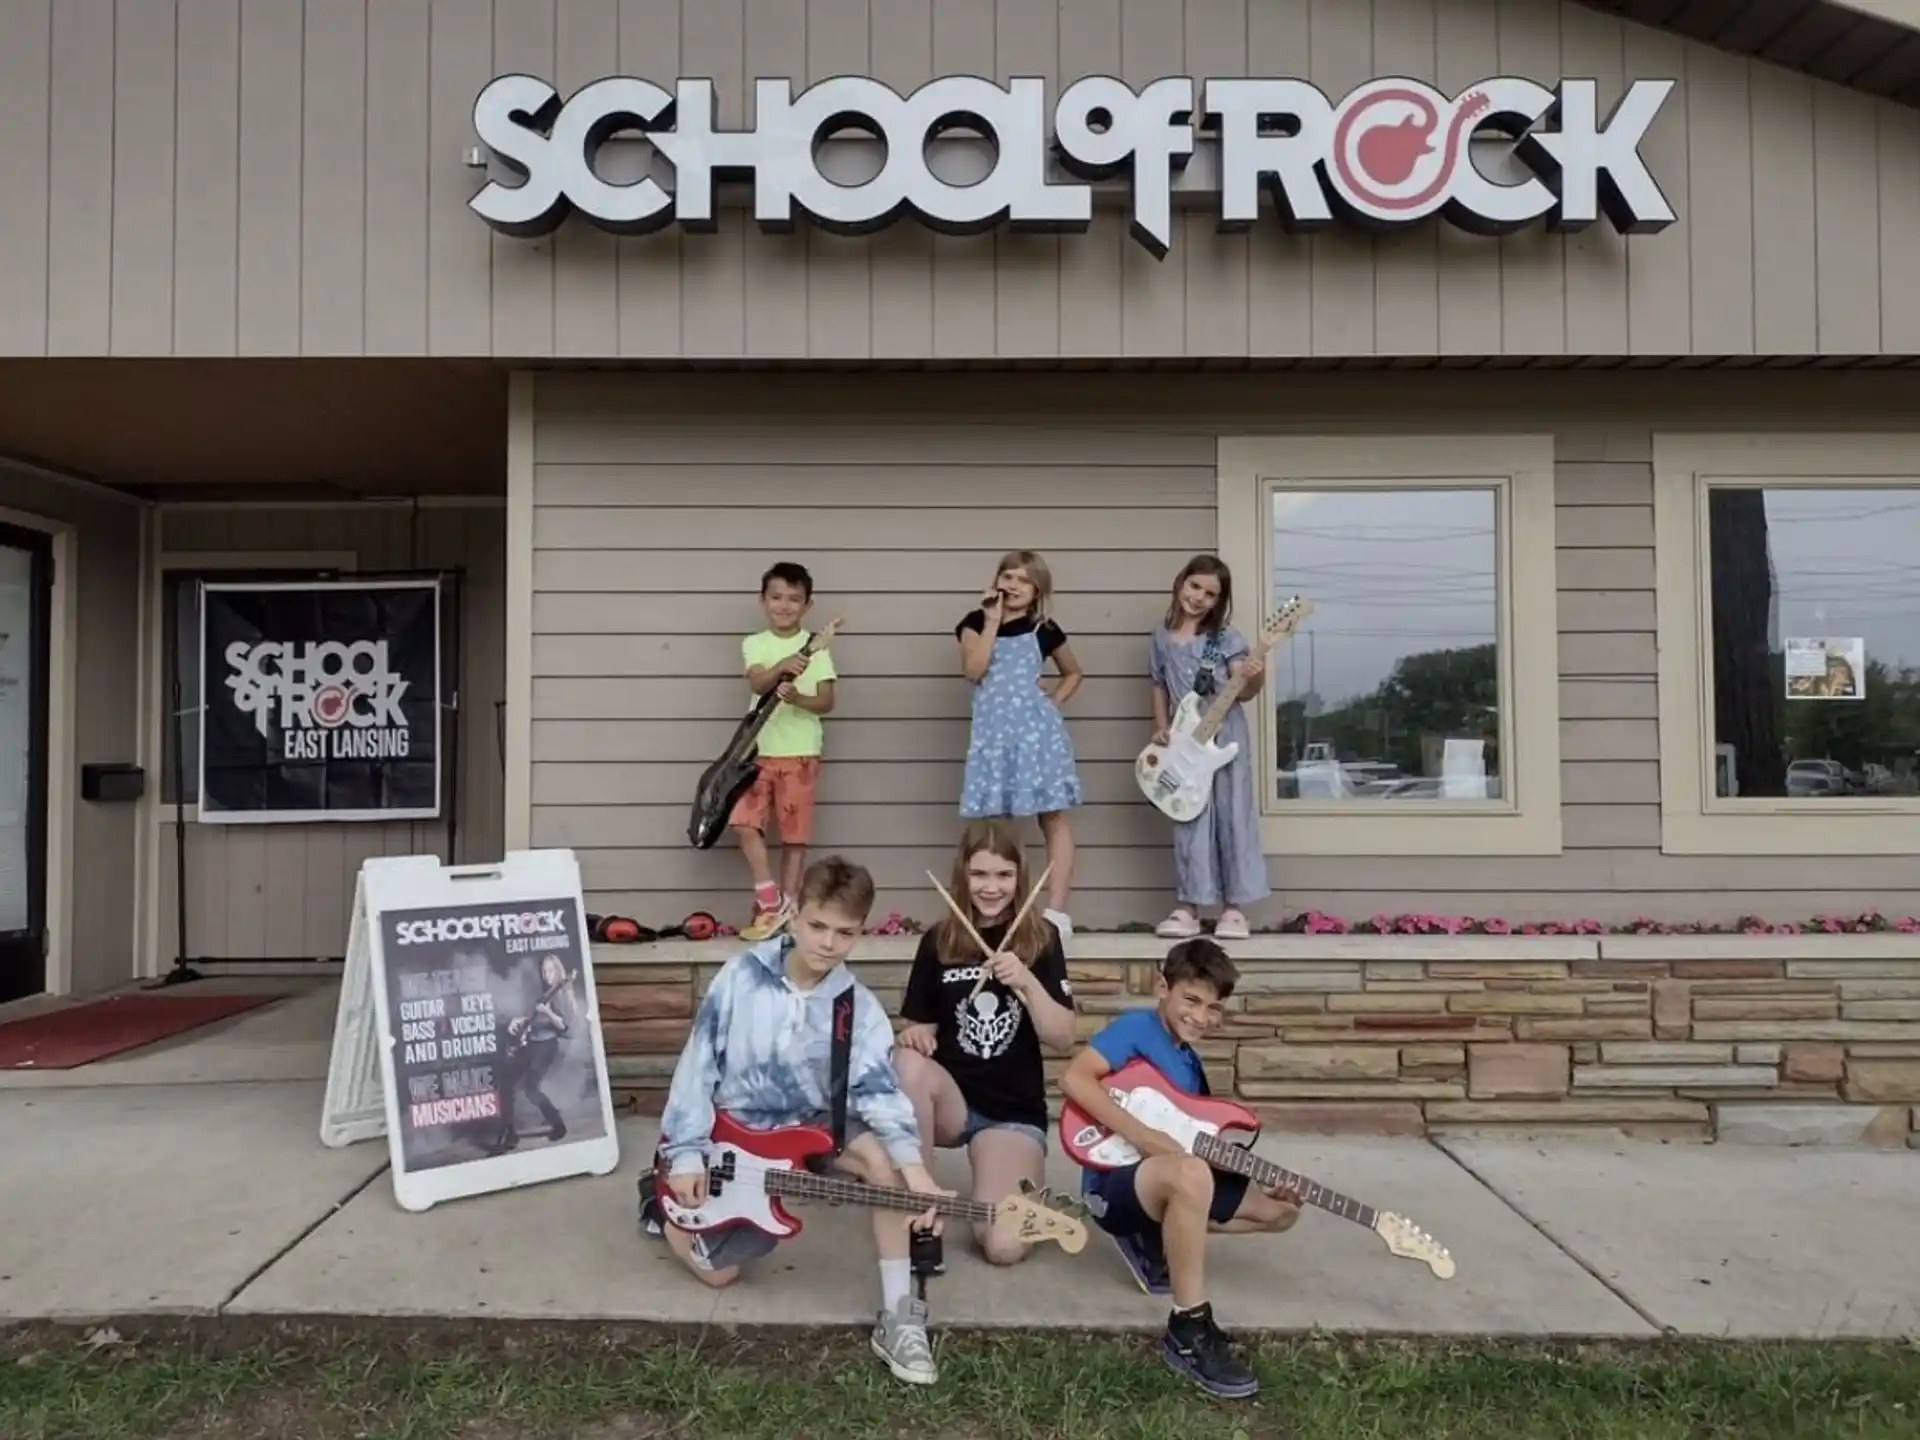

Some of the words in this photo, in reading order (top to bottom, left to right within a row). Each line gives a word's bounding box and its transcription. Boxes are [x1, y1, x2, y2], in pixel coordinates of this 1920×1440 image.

[468, 74, 1092, 228] SCHOOL
[1205, 75, 1678, 228] ROCK
[224, 640, 401, 688] SCHOOL
[277, 681, 412, 728] ROCK
[285, 730, 328, 760] EAST
[332, 729, 409, 759] LANSING
[396, 916, 488, 945] SCHOOL
[501, 910, 566, 936] ROCK
[505, 938, 529, 954] EAST
[942, 967, 984, 983] SCHOO
[400, 999, 445, 1021] GUITAR
[461, 993, 494, 1014] KEYS
[402, 1020, 436, 1042] BASS
[450, 1013, 496, 1036] VOCALS
[404, 1041, 437, 1064] AND
[441, 1033, 497, 1059] DRUMS
[410, 1093, 497, 1128] MUSICIANS
